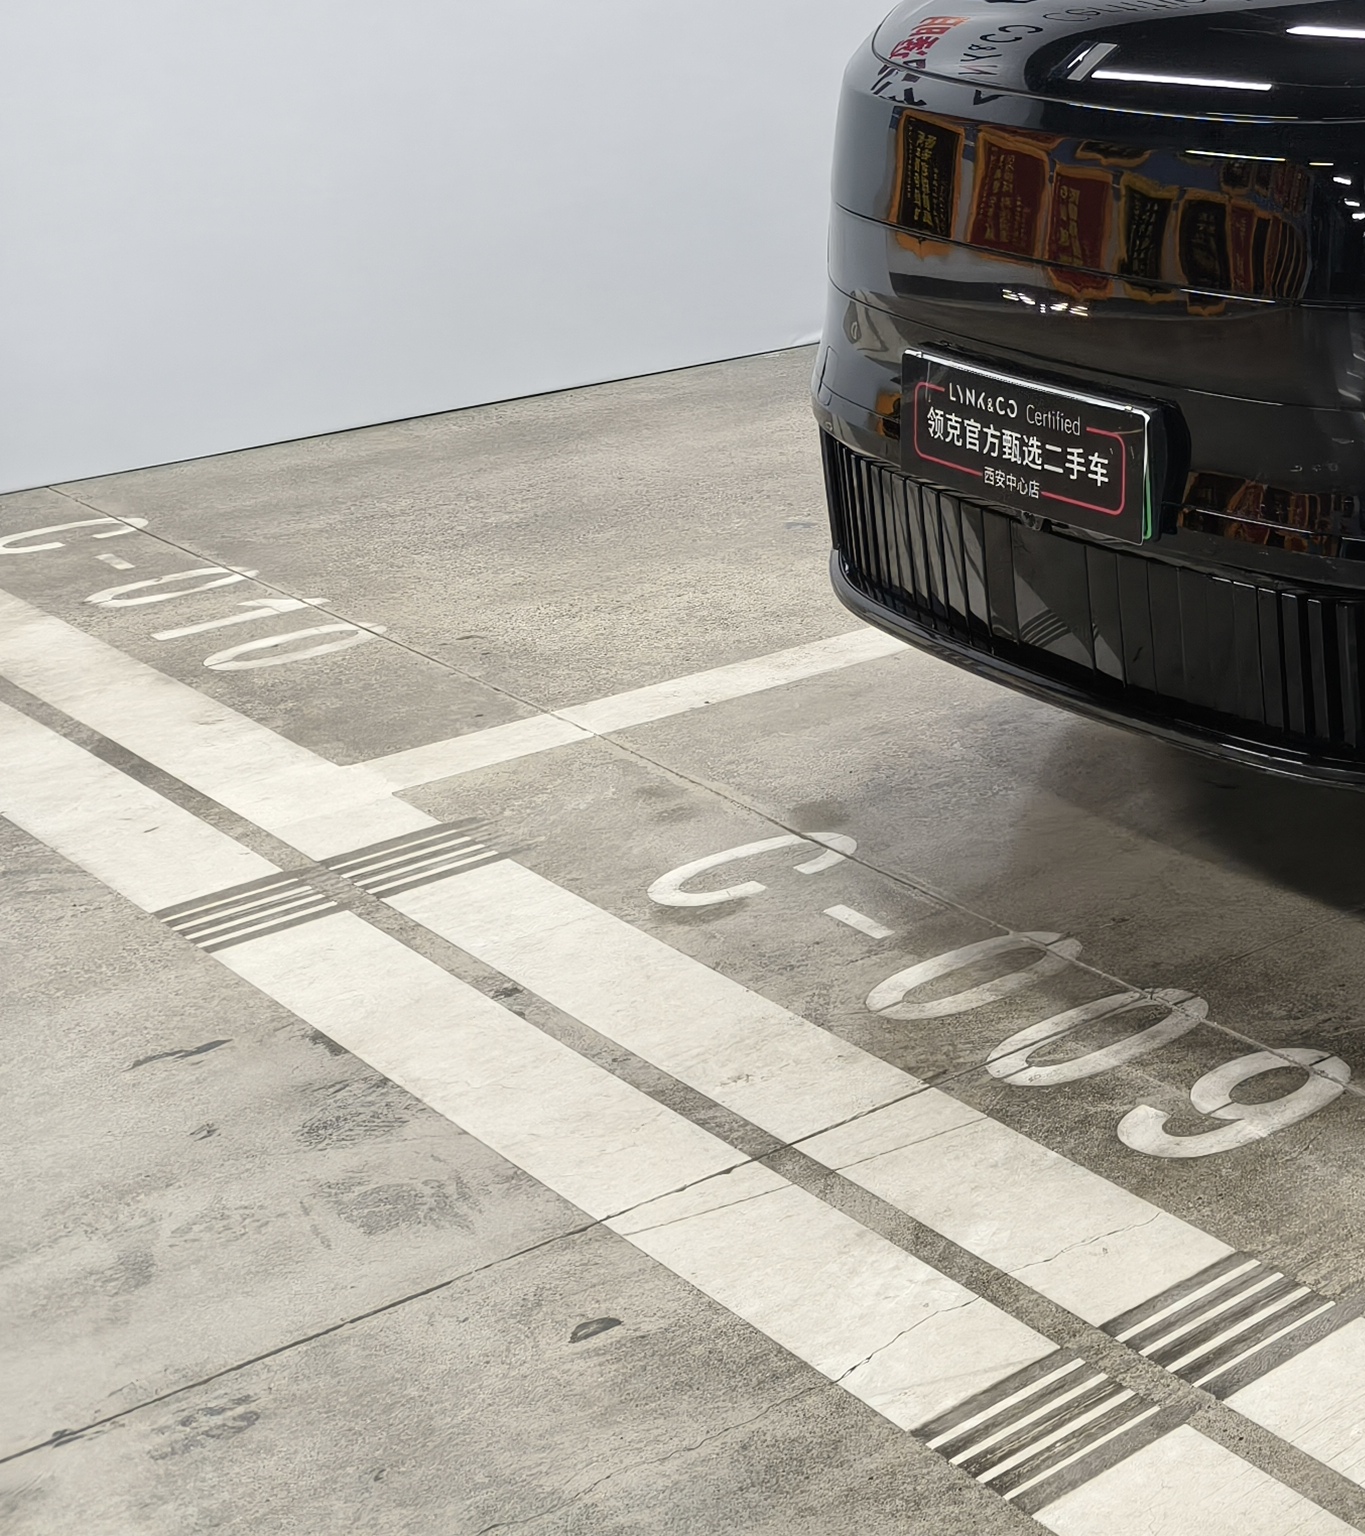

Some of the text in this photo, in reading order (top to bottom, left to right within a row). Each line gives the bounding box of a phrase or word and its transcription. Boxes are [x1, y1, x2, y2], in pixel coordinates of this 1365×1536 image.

[926, 406, 1109, 487] 领克官方甄选二手车
[1026, 404, 1081, 436] Certified
[983, 466, 1040, 499] 西安中心店
[0, 517, 387, 671] C-010
[647, 831, 1352, 1159] C-009
